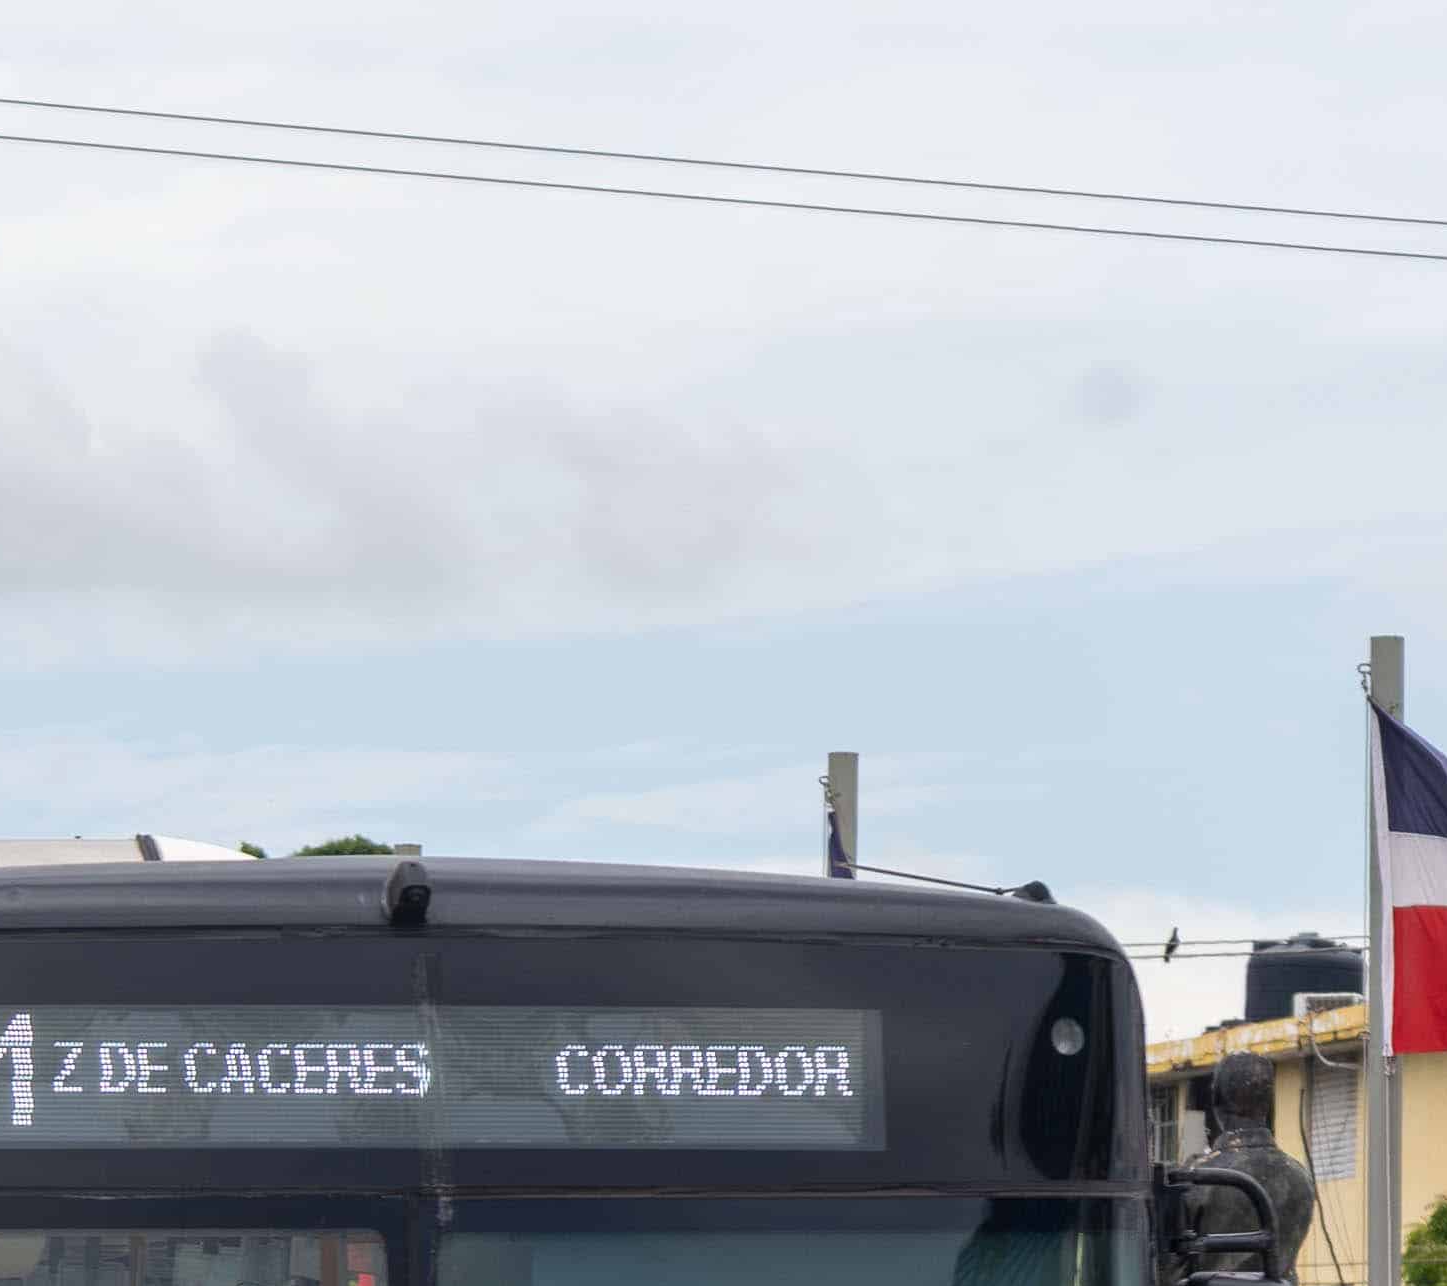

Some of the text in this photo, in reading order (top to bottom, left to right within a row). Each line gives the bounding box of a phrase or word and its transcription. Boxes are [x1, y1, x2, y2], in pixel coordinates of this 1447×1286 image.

[52, 1041, 85, 1094] Z
[99, 1041, 168, 1095] DE
[183, 1041, 430, 1097] CACERES
[555, 1043, 853, 1098] CORREDOR
